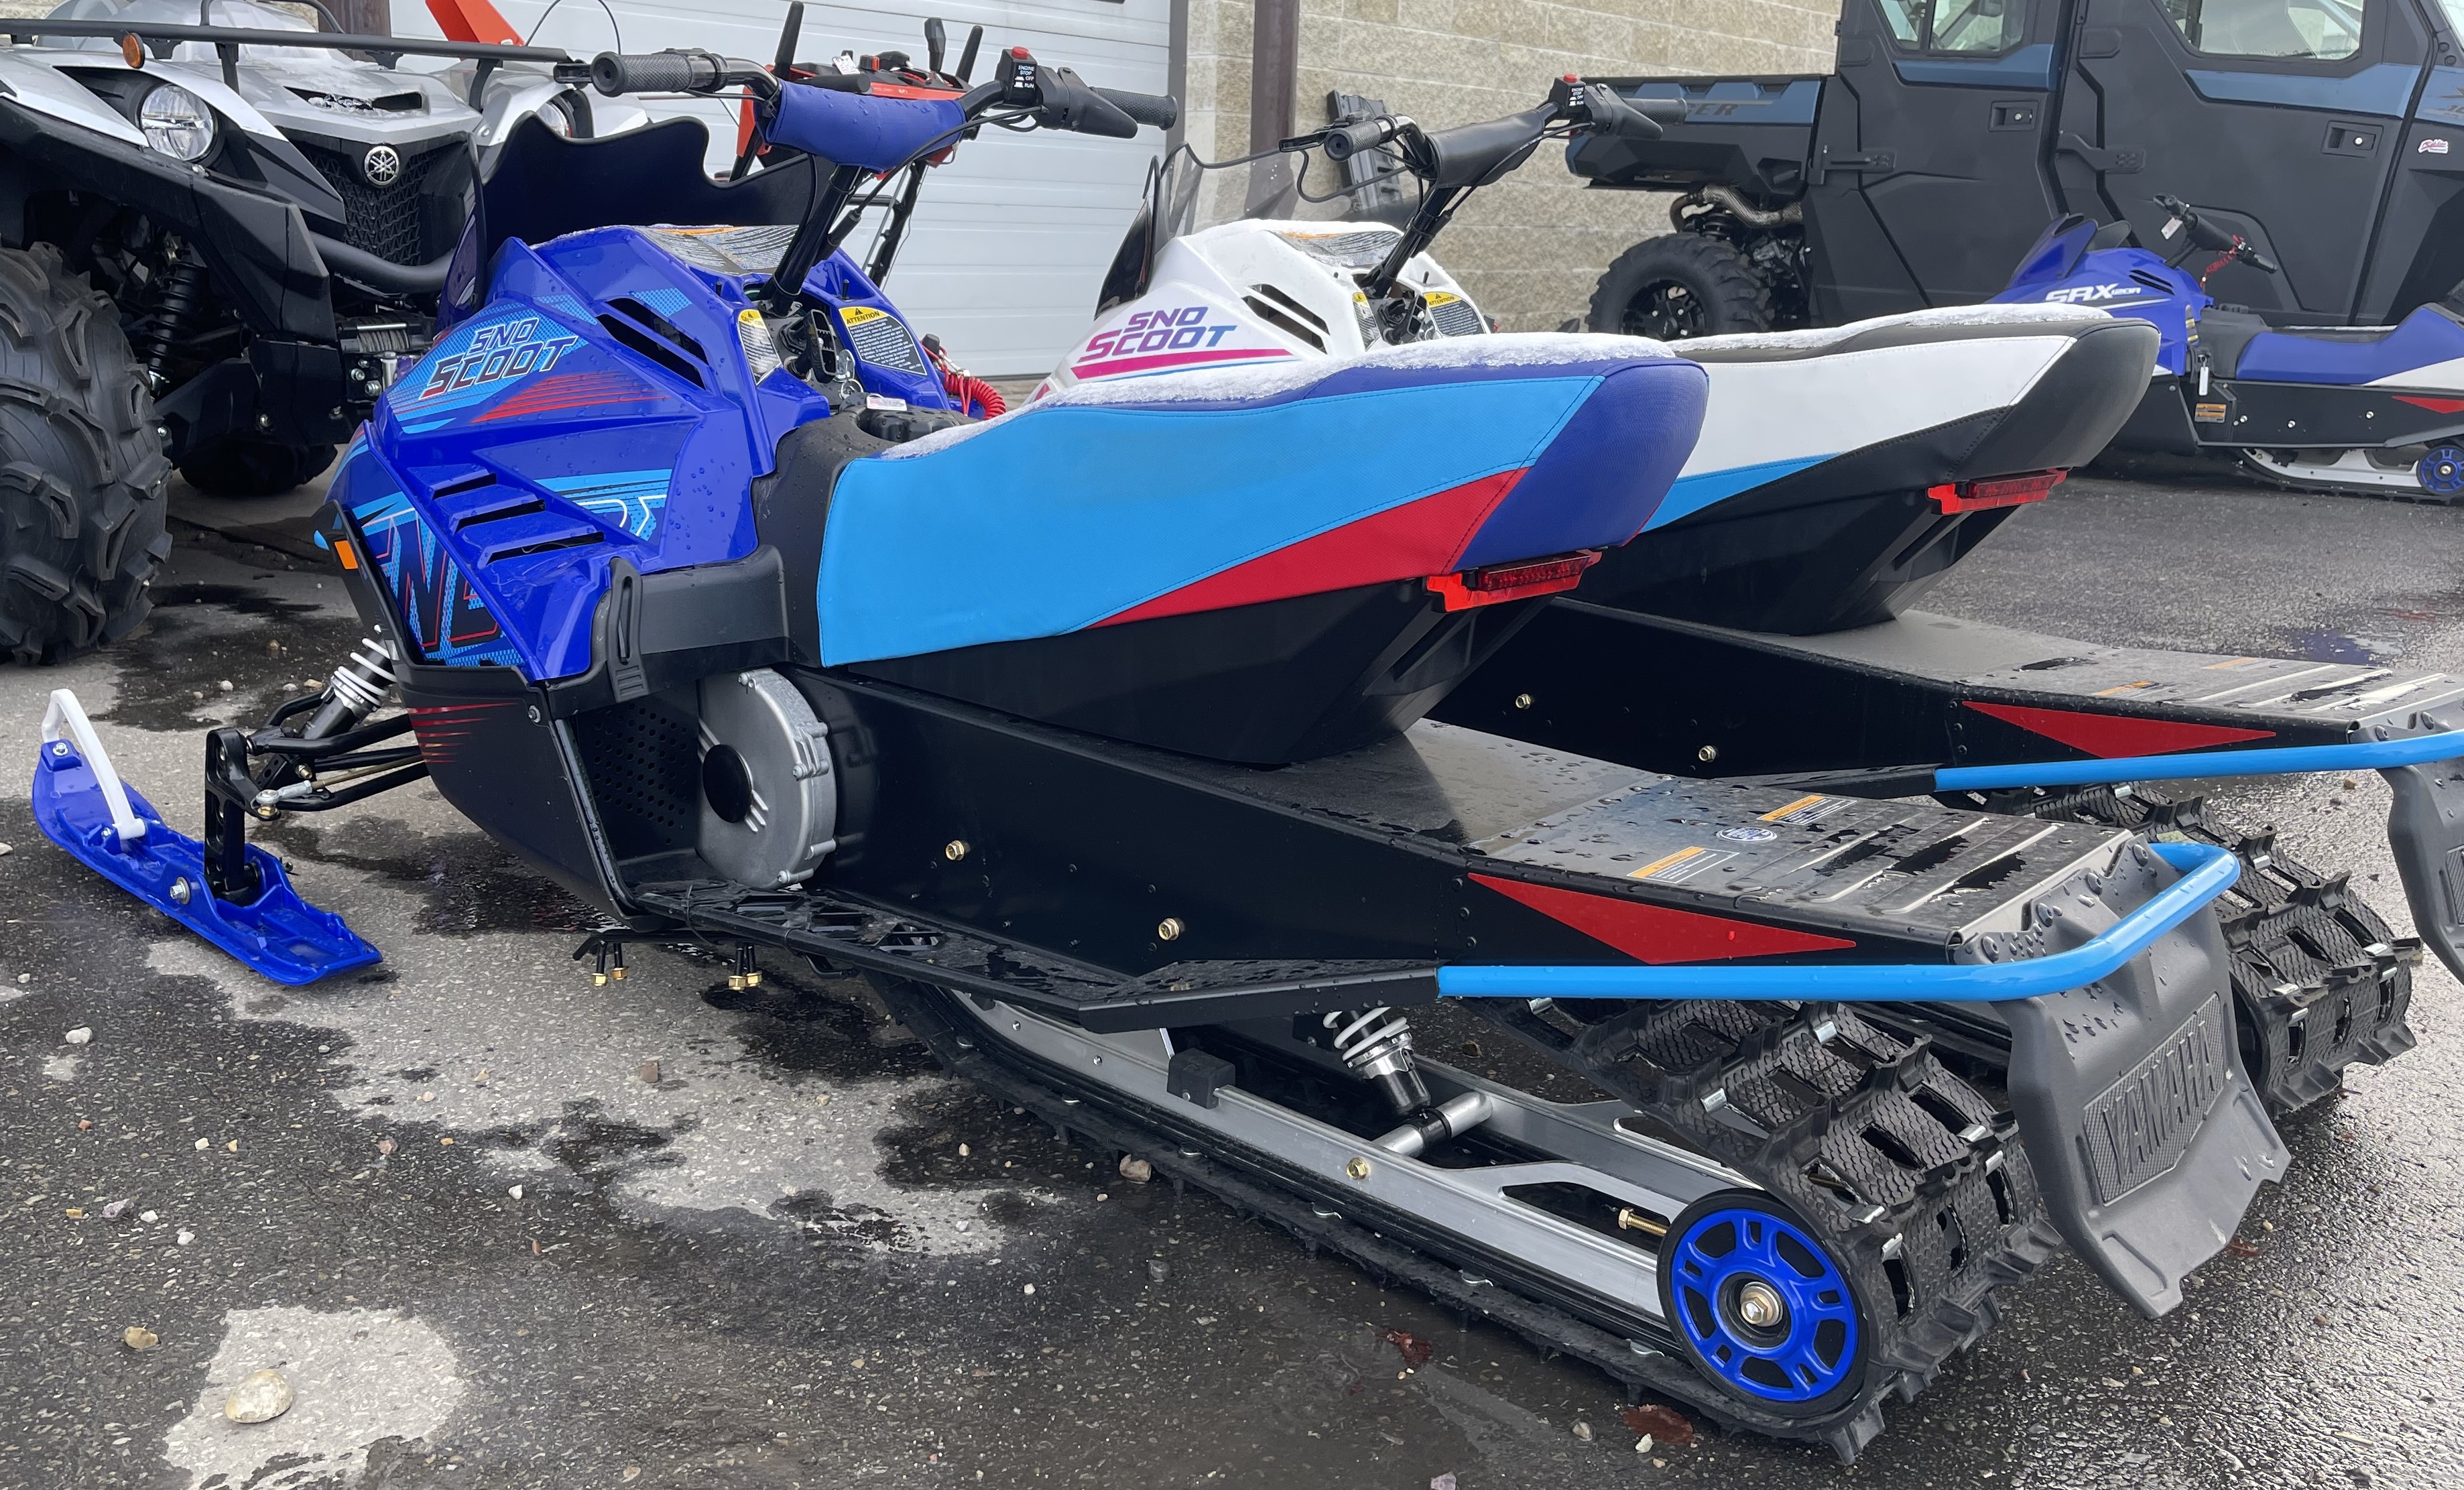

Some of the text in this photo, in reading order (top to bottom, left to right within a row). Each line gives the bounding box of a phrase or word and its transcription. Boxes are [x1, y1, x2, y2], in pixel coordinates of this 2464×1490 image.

[847, 310, 880, 324] ATTENTION
[1123, 306, 1209, 333] SNO
[1428, 295, 1455, 306] ATTENTION
[466, 317, 540, 356] SNO
[1076, 324, 1238, 364] SCOOT
[418, 334, 579, 401] SCOOT
[2102, 1020, 2215, 1186] YAMAHA
